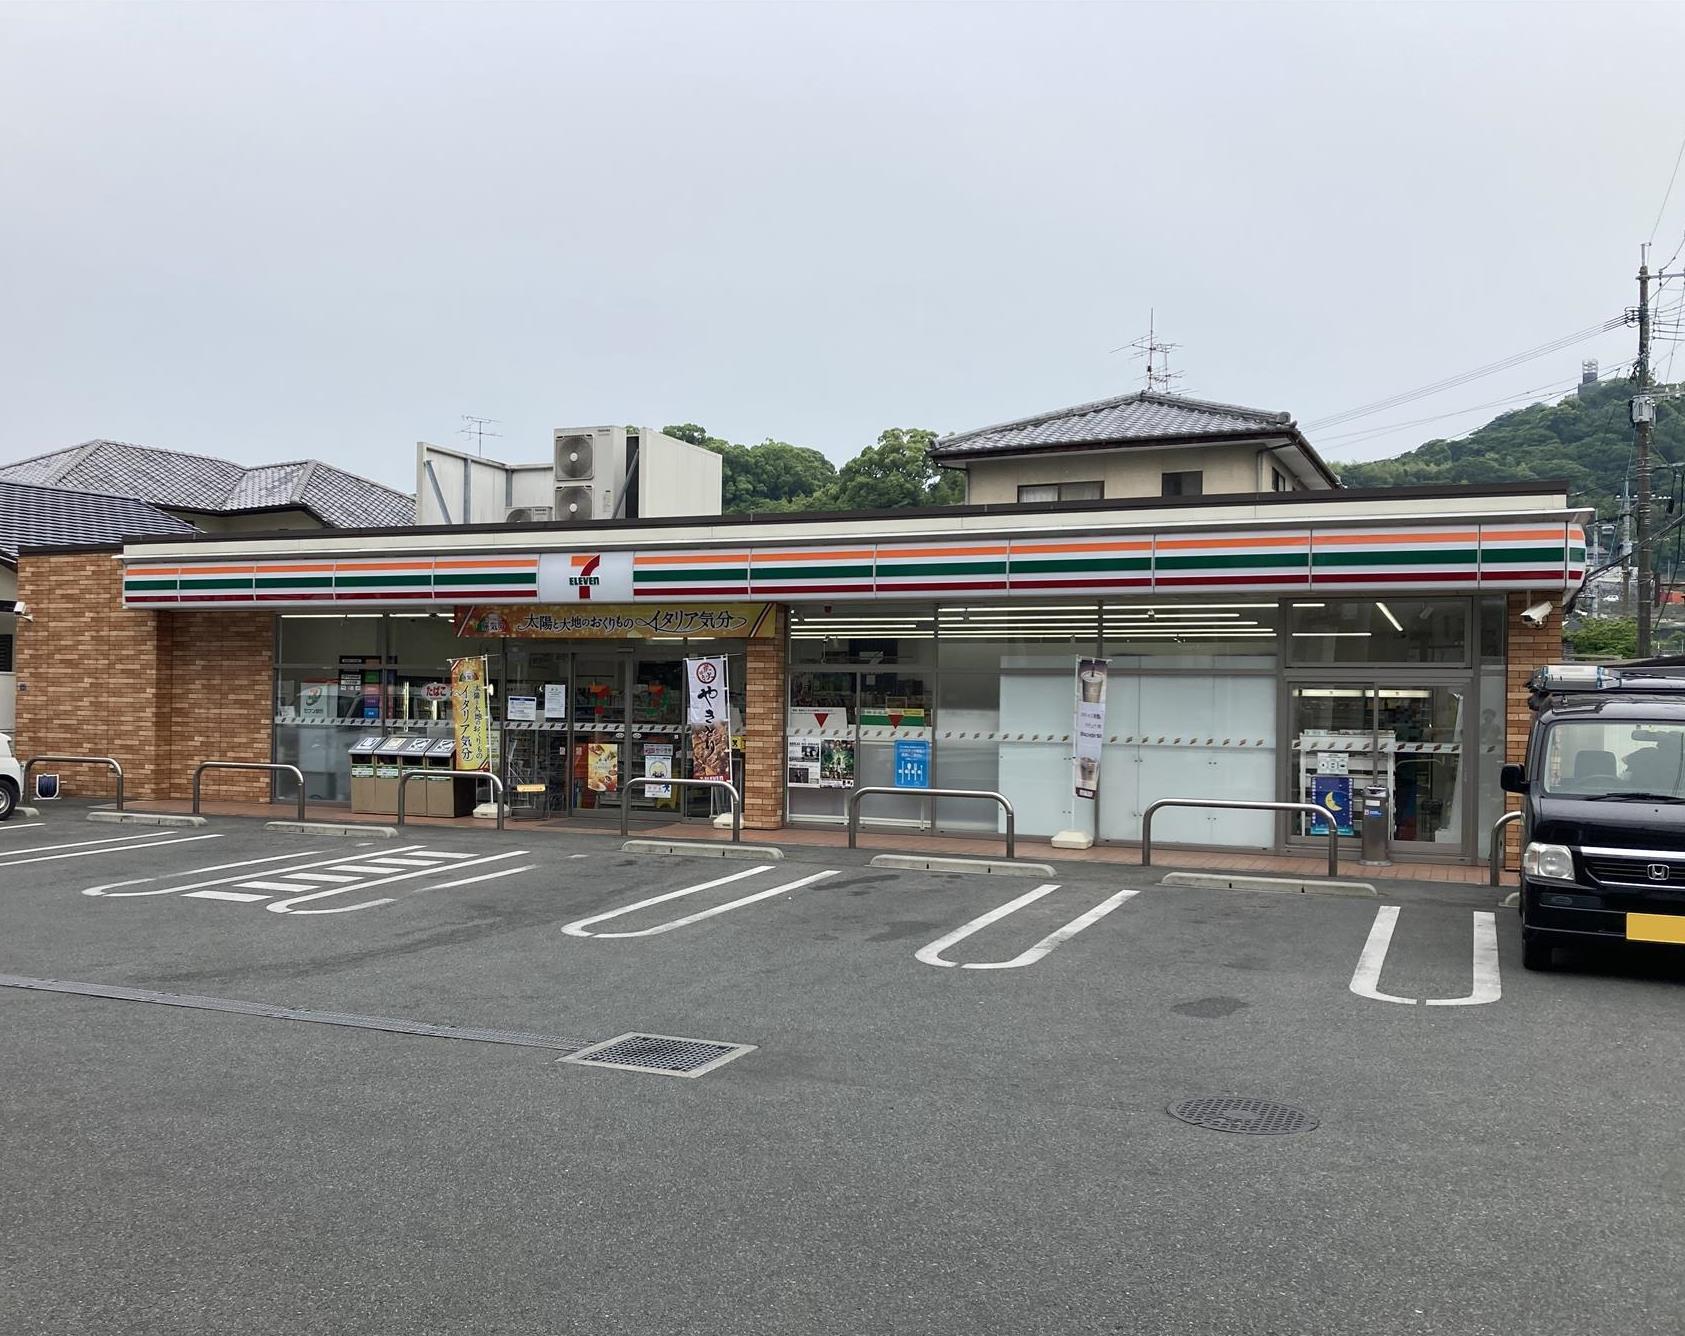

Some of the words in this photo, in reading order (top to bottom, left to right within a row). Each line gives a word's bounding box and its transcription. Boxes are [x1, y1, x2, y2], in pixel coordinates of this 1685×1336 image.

[571, 554, 600, 599] 7
[518, 613, 634, 631] 太陽と大地のおくりもの
[642, 610, 736, 633] イタリア気分
[426, 686, 447, 697] たばこ
[459, 685, 472, 760] イタリア気分
[697, 686, 719, 760] やきとり
